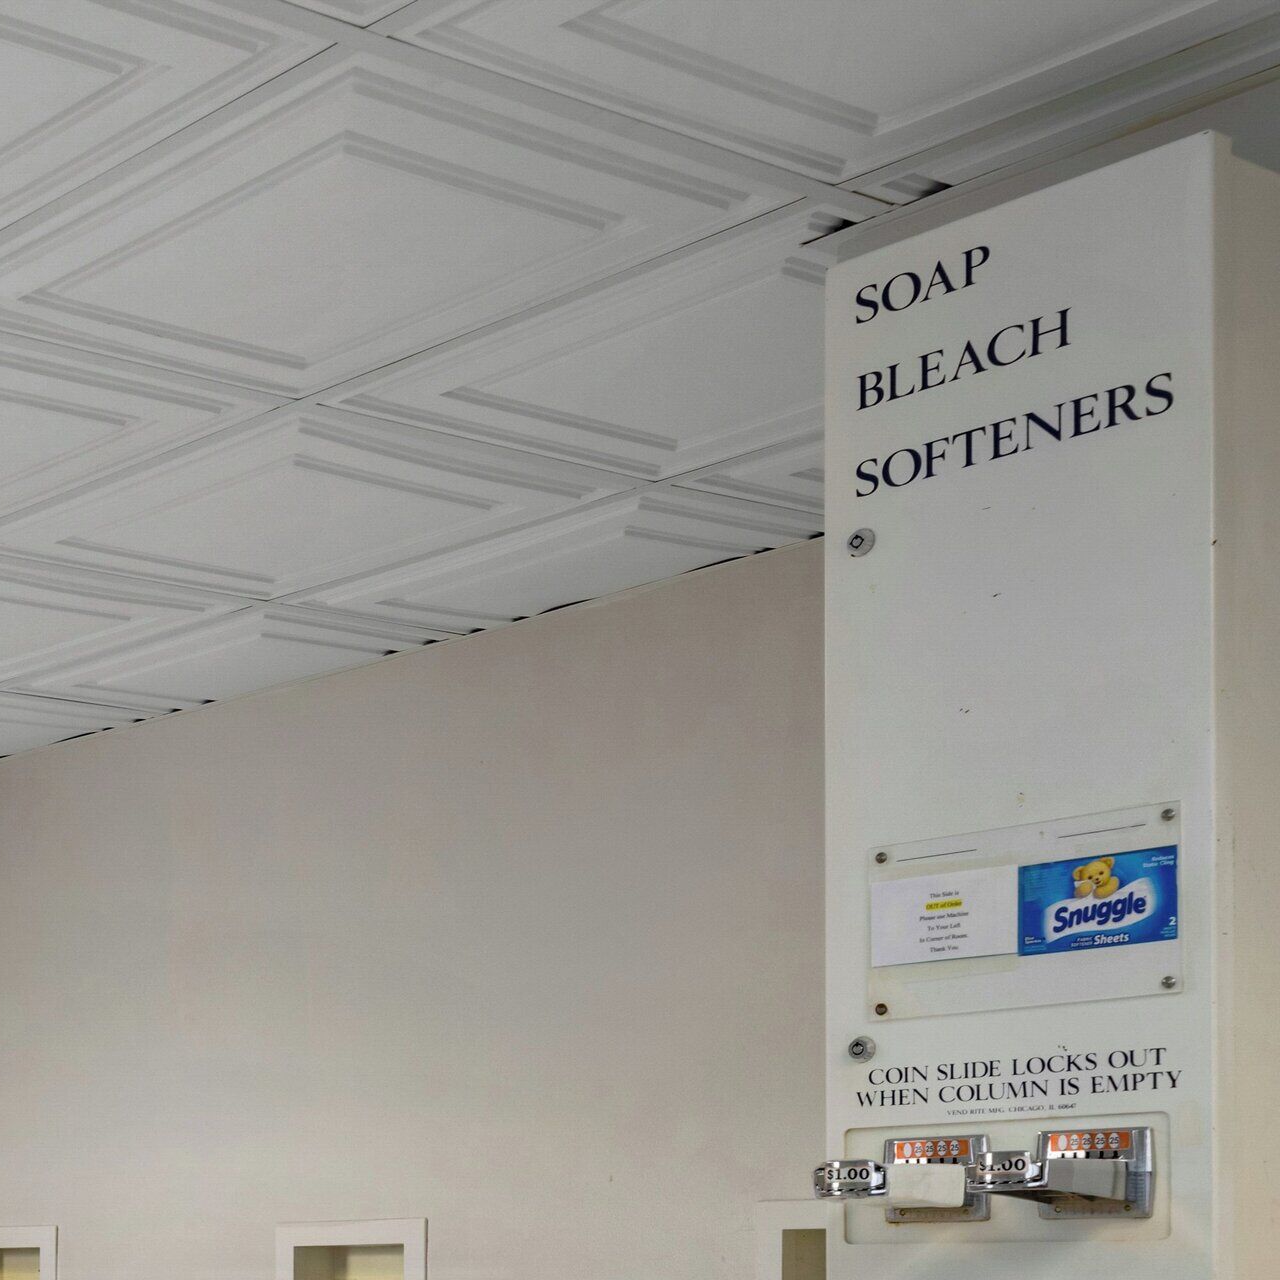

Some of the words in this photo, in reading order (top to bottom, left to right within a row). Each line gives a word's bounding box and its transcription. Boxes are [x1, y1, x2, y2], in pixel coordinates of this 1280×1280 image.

[855, 245, 991, 324] SOAP
[856, 307, 1072, 411] BLEACH
[855, 372, 1174, 497] SOFTENERS
[1052, 891, 1147, 933] Snuggle
[1169, 916, 1176, 926] 2
[1094, 933, 1130, 945] Sheets
[868, 1065, 929, 1086] COIN
[937, 1059, 1001, 1081] SLIDE
[1012, 1052, 1097, 1076] LOCKS
[1108, 1047, 1167, 1069] OUT
[856, 1087, 929, 1107] WHEN
[938, 1079, 1049, 1104] COLUMN
[1059, 1077, 1080, 1096] IS
[1090, 1070, 1182, 1094] EMPTY
[947, 1107, 968, 1116] VEND
[1109, 1136, 1119, 1144] 25
[827, 1168, 870, 1180] $1.00
